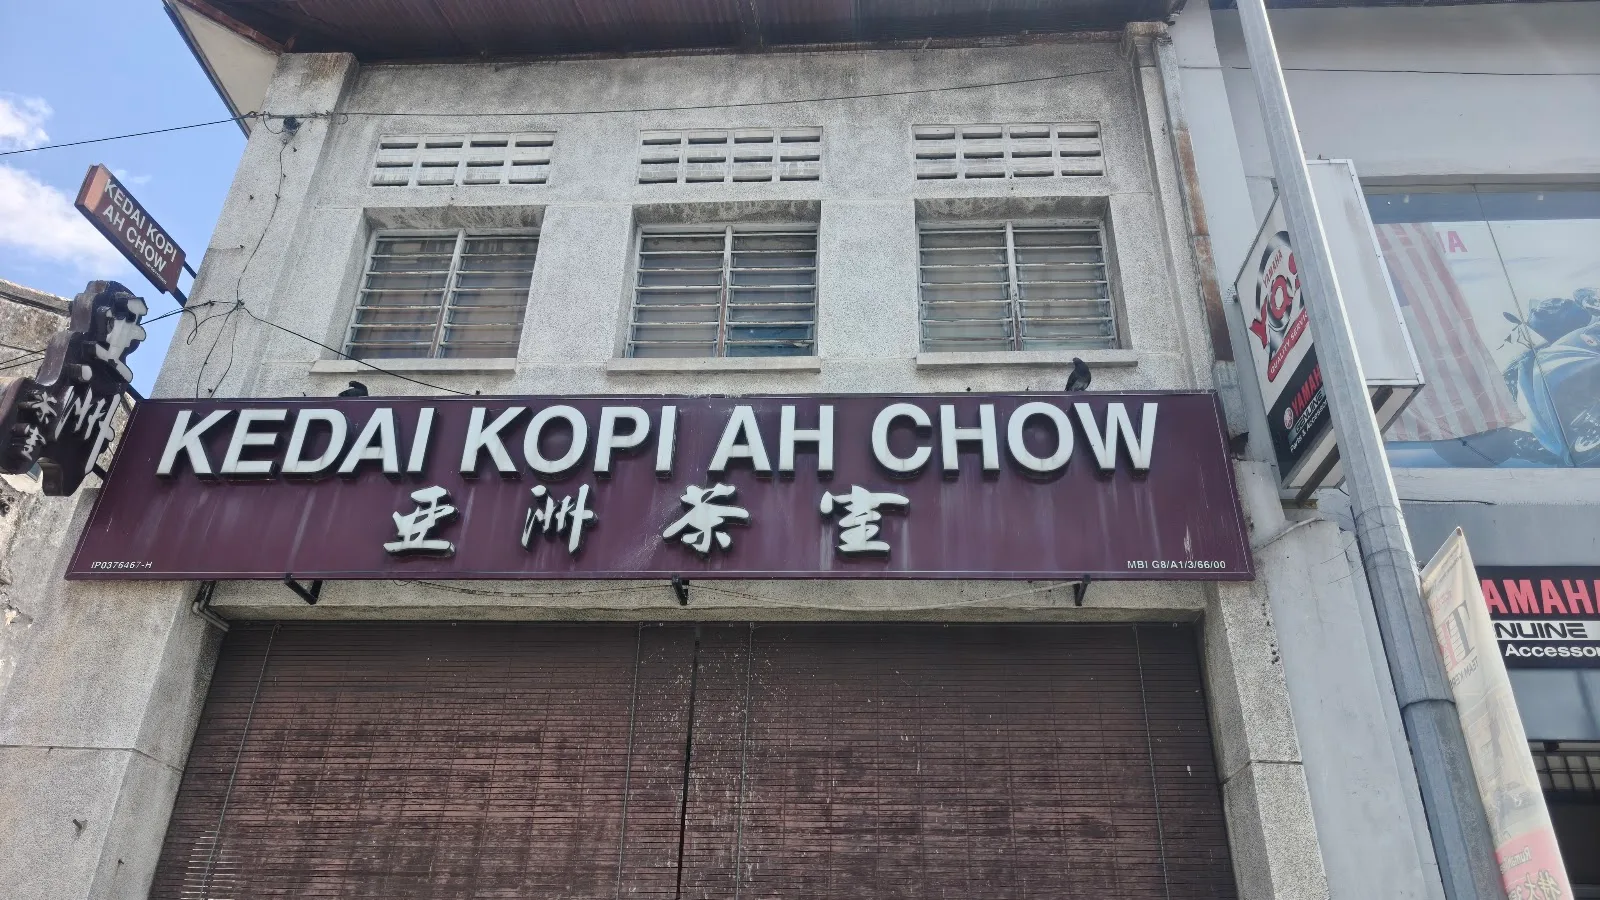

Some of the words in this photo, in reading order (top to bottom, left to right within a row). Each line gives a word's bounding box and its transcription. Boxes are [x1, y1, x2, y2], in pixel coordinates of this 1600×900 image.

[102, 204, 125, 232] AH
[126, 226, 167, 272] CHOW
[104, 179, 146, 229] KEDAI
[146, 223, 177, 262] KOPI
[1263, 249, 1282, 289] YAMAHA
[1270, 339, 1290, 374] QUALITY
[1291, 363, 1323, 417] YAMAH
[1295, 389, 1323, 434] GENUINE
[155, 407, 436, 475] KEDAI
[459, 405, 677, 474] KOPI
[707, 404, 835, 472] AH
[871, 401, 1159, 472] CHOW
[383, 483, 910, 553] 亚洲茶室
[1127, 560, 1149, 569] MBI
[1151, 560, 1226, 569] G8/A1/3/66/00
[1481, 579, 1600, 614] AMAH
[1493, 622, 1588, 639] NUINE
[1505, 643, 1600, 658] Accesso
